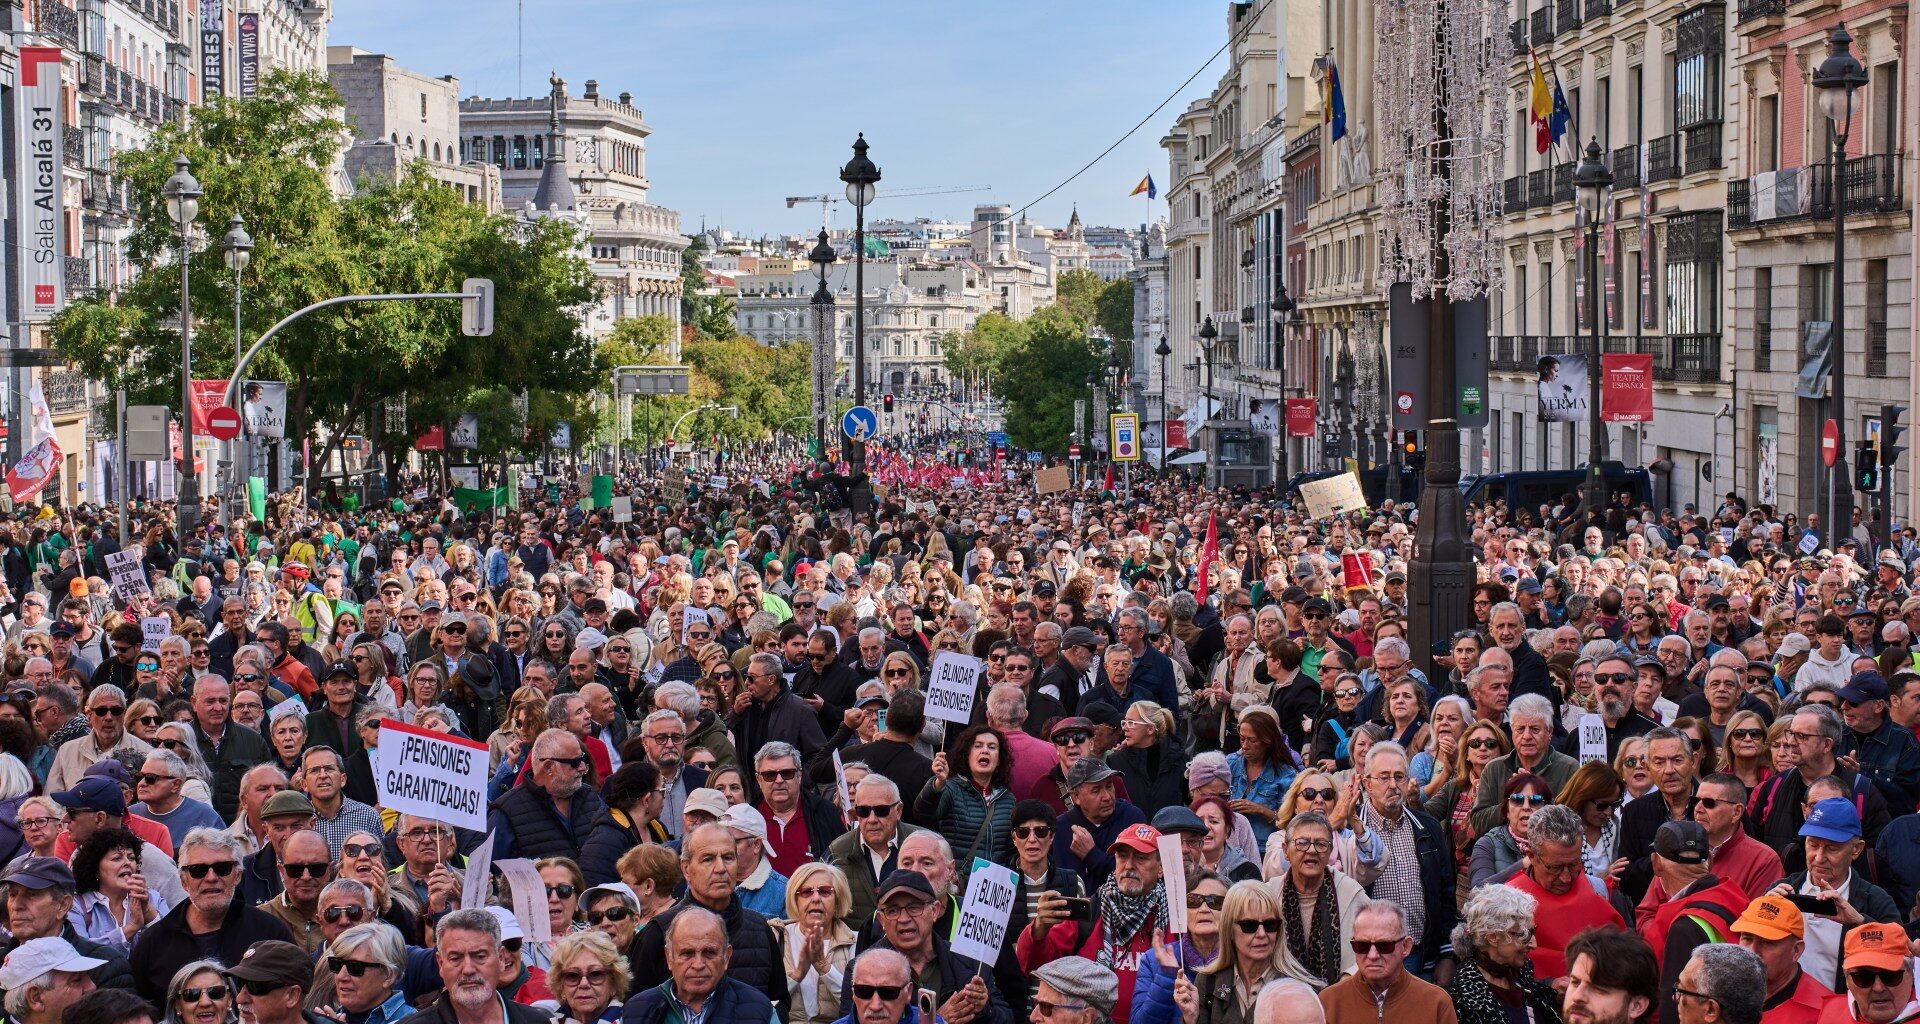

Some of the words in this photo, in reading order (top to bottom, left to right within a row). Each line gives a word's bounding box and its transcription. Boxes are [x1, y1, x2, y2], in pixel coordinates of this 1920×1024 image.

[242, 33, 256, 58] VIVAS
[204, 33, 220, 108] UJERES
[33, 107, 52, 131] 31
[32, 142, 53, 211] Alcalá
[35, 219, 54, 264] Sala
[1611, 374, 1644, 382] TEATRO
[1612, 382, 1648, 390] ESPAÑOL
[1541, 398, 1587, 411] YERMA
[245, 416, 283, 428] YERMA
[1251, 423, 1278, 431] YERMA
[113, 552, 127, 564] LA
[120, 572, 132, 582] ES
[147, 623, 166, 635] BLINDAR
[941, 662, 975, 686] BLINDAR
[928, 687, 973, 712] PENSIONES!
[400, 736, 472, 776] ¡PENSIONES
[386, 769, 480, 816] GARANTIZADAS!
[977, 878, 1012, 914] BLINDAR
[957, 911, 1006, 951] PENSIONES!
